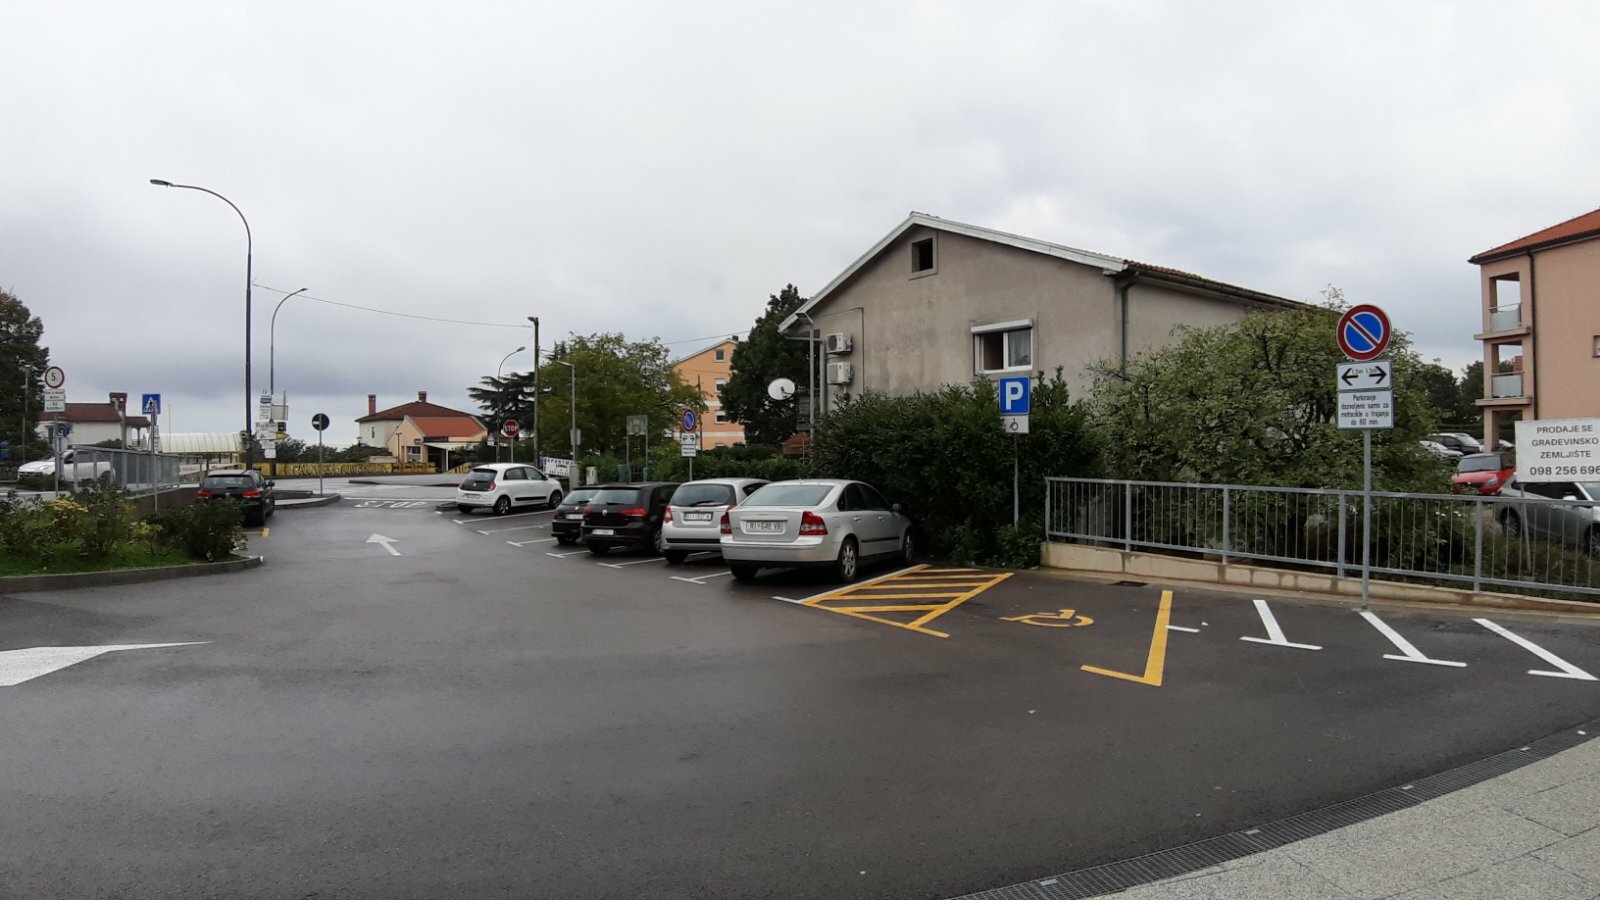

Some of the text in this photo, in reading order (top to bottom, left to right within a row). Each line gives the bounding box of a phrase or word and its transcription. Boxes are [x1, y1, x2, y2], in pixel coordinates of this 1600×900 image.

[51, 372, 56, 382] 5
[1005, 381, 1024, 411] P
[1353, 394, 1377, 402] Parkiranje
[1341, 403, 1366, 412] dozvoljeno
[1371, 410, 1389, 418] trajanju
[1536, 424, 1593, 434] PRODAJE SE
[1531, 437, 1599, 447] GRAĐEVINSKO
[1540, 450, 1592, 459] ZEMLJIŠTE
[1529, 465, 1600, 476] 098 256 696
[354, 500, 427, 509] STOP
